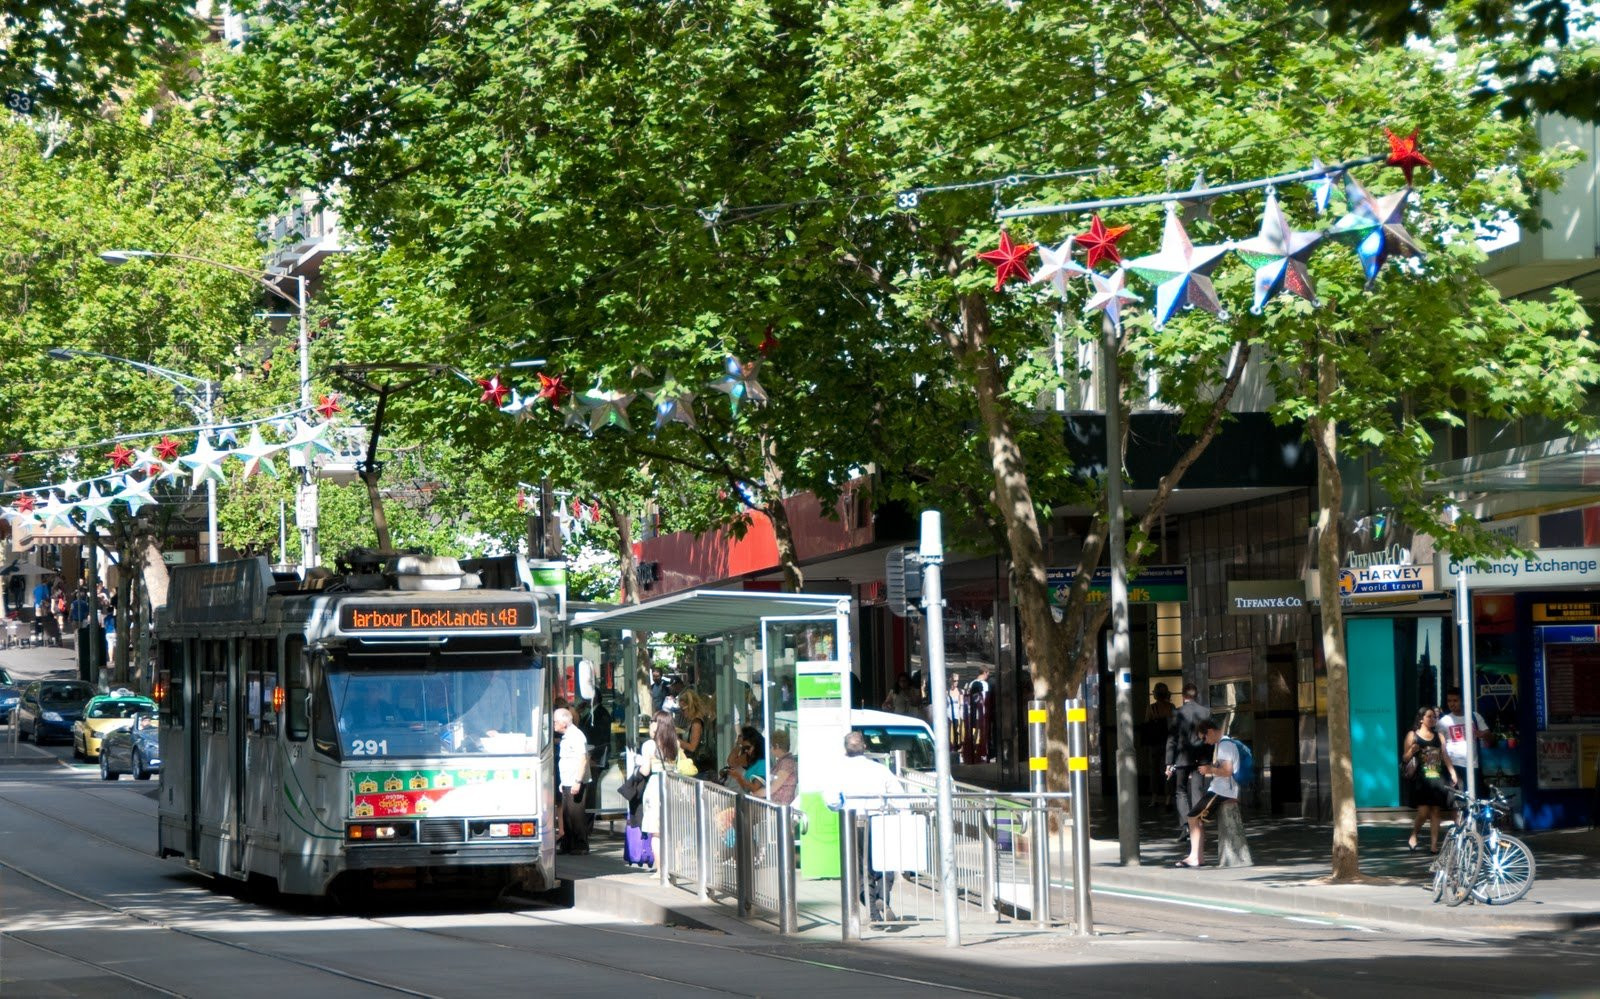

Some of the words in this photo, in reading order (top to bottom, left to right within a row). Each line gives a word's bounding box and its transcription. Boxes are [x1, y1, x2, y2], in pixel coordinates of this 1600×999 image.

[9, 93, 31, 111] 33
[899, 193, 918, 207] 33
[1359, 567, 1422, 581] HARVEY
[1525, 559, 1597, 574] Exchange
[1360, 584, 1388, 592] world
[1392, 581, 1421, 589] travel
[498, 607, 517, 626] 48
[352, 739, 388, 755] 291
